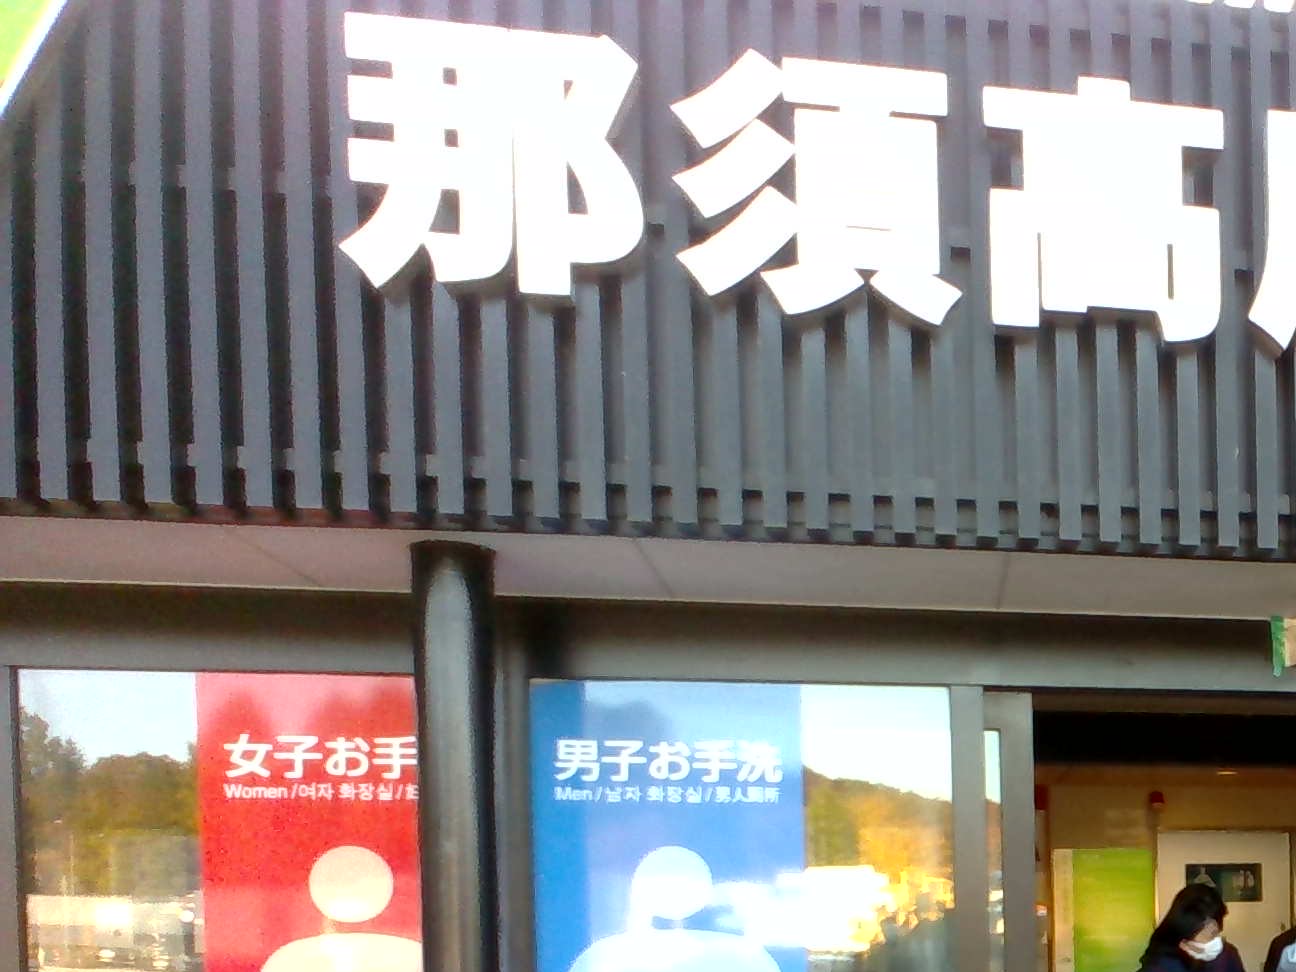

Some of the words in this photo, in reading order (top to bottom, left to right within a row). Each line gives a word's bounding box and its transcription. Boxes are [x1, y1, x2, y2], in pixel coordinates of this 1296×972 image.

[223, 733, 418, 779] 女子お手
[553, 738, 784, 783] 男子お手洗
